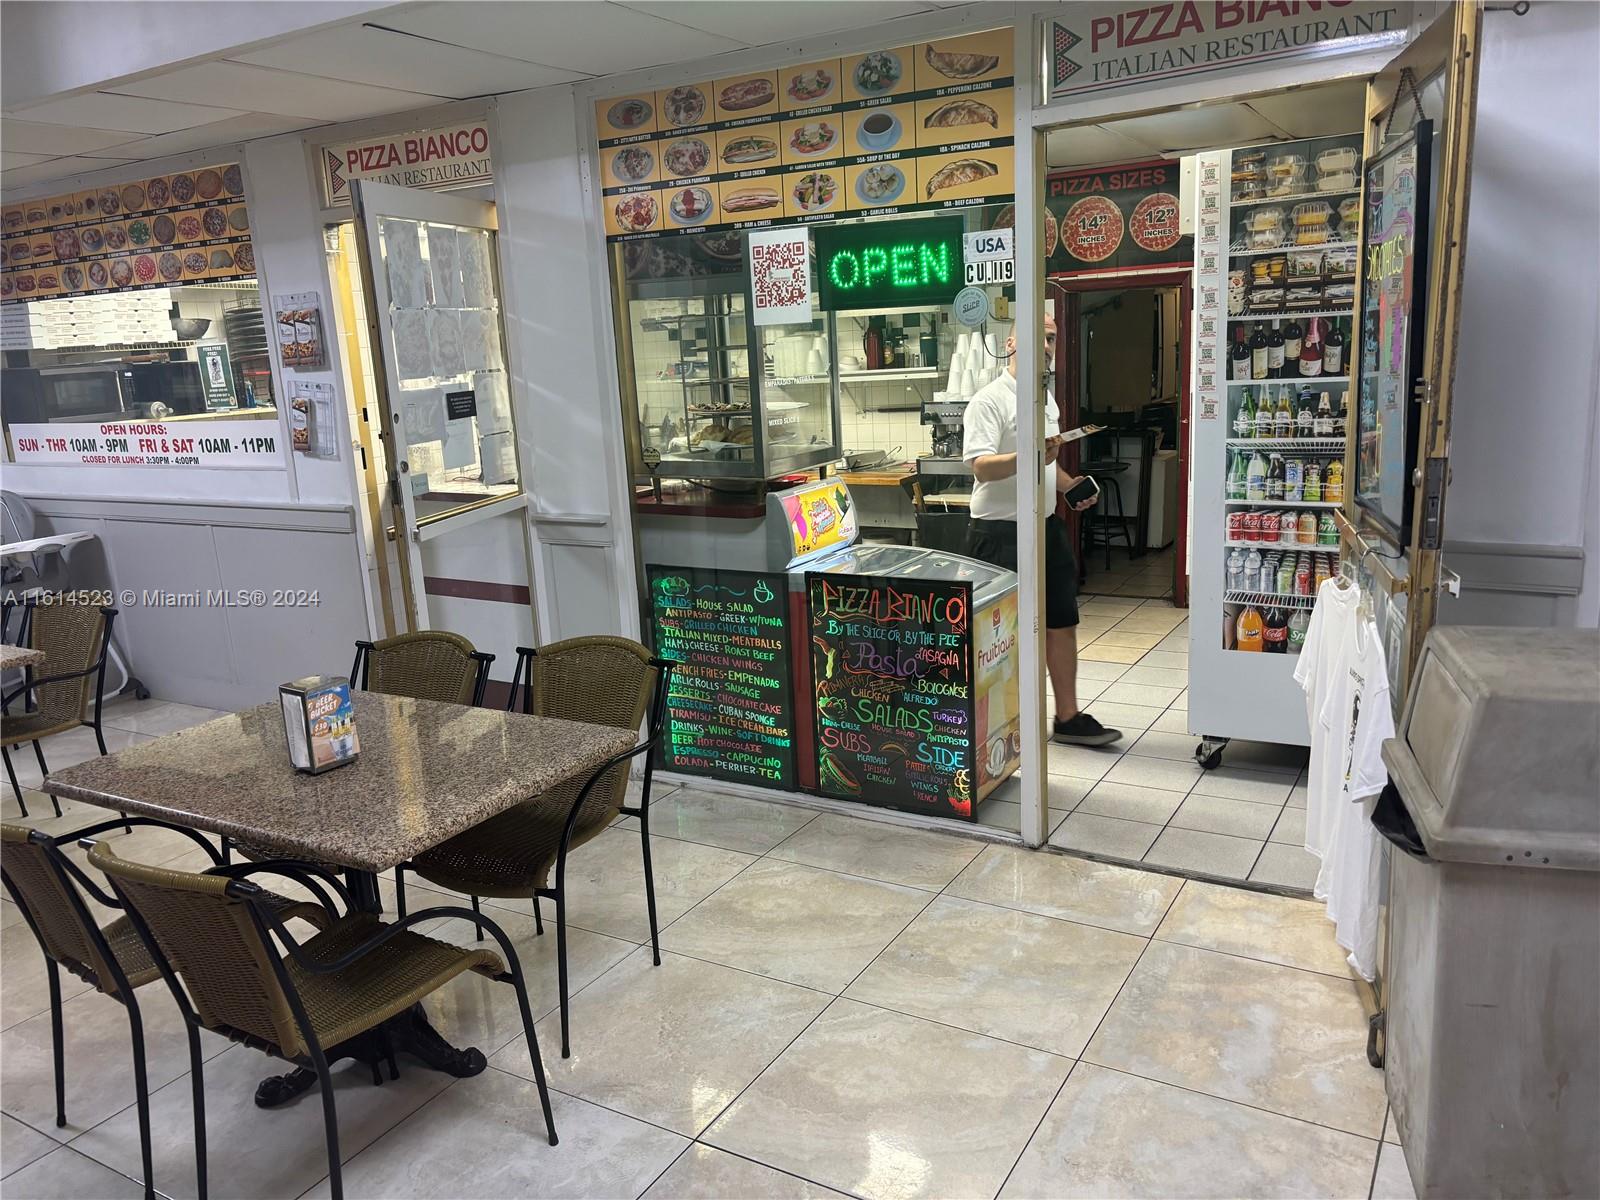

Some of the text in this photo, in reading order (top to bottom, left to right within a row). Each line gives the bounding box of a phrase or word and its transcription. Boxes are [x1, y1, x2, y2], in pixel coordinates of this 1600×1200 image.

[1091, 1, 1205, 53] PIZZA
[1092, 9, 1396, 82] ITALIAN RESTAURANT
[346, 127, 489, 173] PIZZA BIANCO
[404, 158, 491, 185] RESTAURANT
[1050, 169, 1167, 198] PIZZA SIZES
[1077, 235, 1106, 244] INCHES
[1144, 228, 1173, 237] INCHES
[976, 237, 1006, 254] USA
[828, 241, 949, 289] OPEN
[100, 424, 168, 436] OPEN HOURS:
[18, 438, 39, 452] SUN
[46, 438, 68, 452] THR
[69, 438, 98, 453] 10AM
[106, 438, 129, 453] 9PM
[139, 438, 157, 453] FRI
[161, 438, 169, 453] &
[172, 438, 194, 453] SAT
[198, 438, 231, 454] 10AM
[241, 437, 276, 454] 11PM
[81, 455, 200, 465] CLOSED FOR LUNCH 3:30PM 4:00PM
[727, 602, 754, 613] SALAD
[820, 579, 964, 624] PIZZA BIANCO
[665, 608, 712, 619] ANTIPASTO
[684, 619, 717, 631] GRILLED
[717, 621, 758, 635] CHICKEN
[845, 624, 860, 637] THE
[862, 625, 887, 640] SLICE
[887, 628, 902, 644] OR
[919, 631, 935, 645] THE
[938, 633, 961, 647] PIE
[663, 627, 782, 650] ITALIAN MIXED MEATBALLS
[691, 652, 730, 666] CHICKEN
[731, 658, 763, 672] WINGS
[724, 645, 751, 657] ROAST
[753, 648, 775, 661] BEEF
[850, 641, 926, 679] Pasta
[977, 634, 1015, 669] fruitique
[695, 679, 720, 691] ROLLS
[724, 682, 761, 699] SAUSAGE
[851, 687, 938, 706] CHICKEN ALFREDO
[310, 700, 338, 720] BUCKET
[667, 697, 776, 726] CHEESECAKE CUBAN SPONGE
[717, 694, 759, 709] CHOCOLATE
[759, 702, 782, 714] CAKE
[669, 708, 711, 721] TIRAMISU
[719, 715, 736, 726] ICE
[766, 727, 788, 737] BARS
[850, 699, 963, 733] SALADS TURKEY
[708, 725, 733, 737] WINE
[736, 729, 759, 741] SOFT
[760, 734, 791, 748] DRINKS
[820, 727, 872, 753] SUBS
[926, 733, 969, 747] ANTIPASTO
[934, 724, 967, 736] CHICKEN
[697, 737, 714, 747] HOT
[716, 739, 762, 754] CHOCOLATE
[916, 742, 965, 768] SIDE
[673, 745, 781, 768] ESPRESSO CAPPUCINO
[674, 756, 709, 768] COLADA
[758, 767, 782, 780] TEA
[911, 780, 939, 793] WINGS
